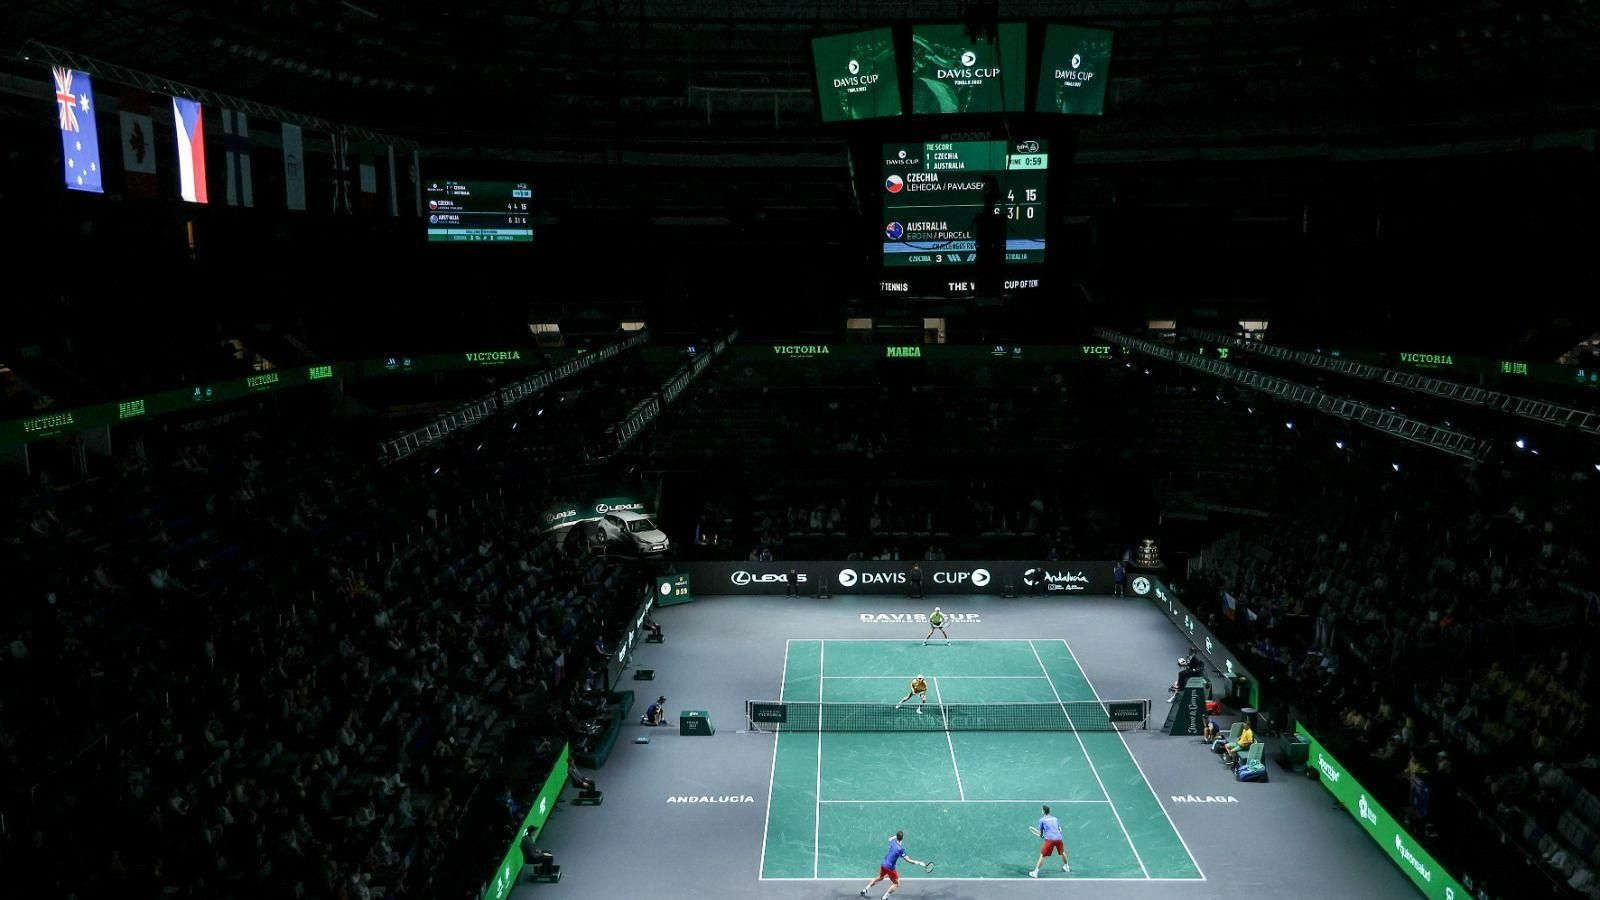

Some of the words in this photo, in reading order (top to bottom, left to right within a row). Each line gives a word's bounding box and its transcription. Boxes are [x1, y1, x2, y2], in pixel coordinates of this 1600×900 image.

[937, 68, 972, 79] DAVIS
[974, 68, 1001, 78] CUP
[1054, 69, 1077, 80] DAVIS
[1077, 71, 1094, 81] CUP
[833, 76, 859, 88] DAVIS
[859, 74, 878, 84] CUP
[935, 143, 953, 151] SCORE
[933, 152, 959, 160] CZECHIA
[933, 161, 965, 170] AUSTRALIA
[1025, 157, 1042, 166] 0:59
[906, 172, 939, 183] CZECHIA
[906, 183, 942, 192] LEHECKA
[1007, 189, 1015, 201] 4
[1025, 188, 1037, 201] 15
[1007, 207, 1014, 219] 3
[1026, 206, 1034, 219] 0
[906, 221, 948, 231] AUSTRALIA
[938, 231, 972, 239] PURCELL
[935, 254, 943, 263] 3
[885, 282, 909, 292] TENNIS
[948, 282, 968, 291] THE
[1004, 280, 1019, 290] CUP
[1019, 280, 1029, 289] OF
[773, 345, 830, 354] VICTORIA
[886, 346, 922, 358] MARCA
[465, 351, 521, 361] VICTORIA
[1400, 352, 1453, 365] VICTORIA
[309, 365, 333, 380] MARCA
[246, 372, 279, 388] VICTORIA
[23, 411, 75, 433] VICTORIA
[608, 503, 643, 511] LEXUS
[862, 571, 906, 584] DAVIS
[933, 570, 970, 584] CUP
[1043, 570, 1090, 584] Andalucía
[666, 795, 755, 803] ANDALUCÍA
[1171, 795, 1239, 803] MÁLAGA
